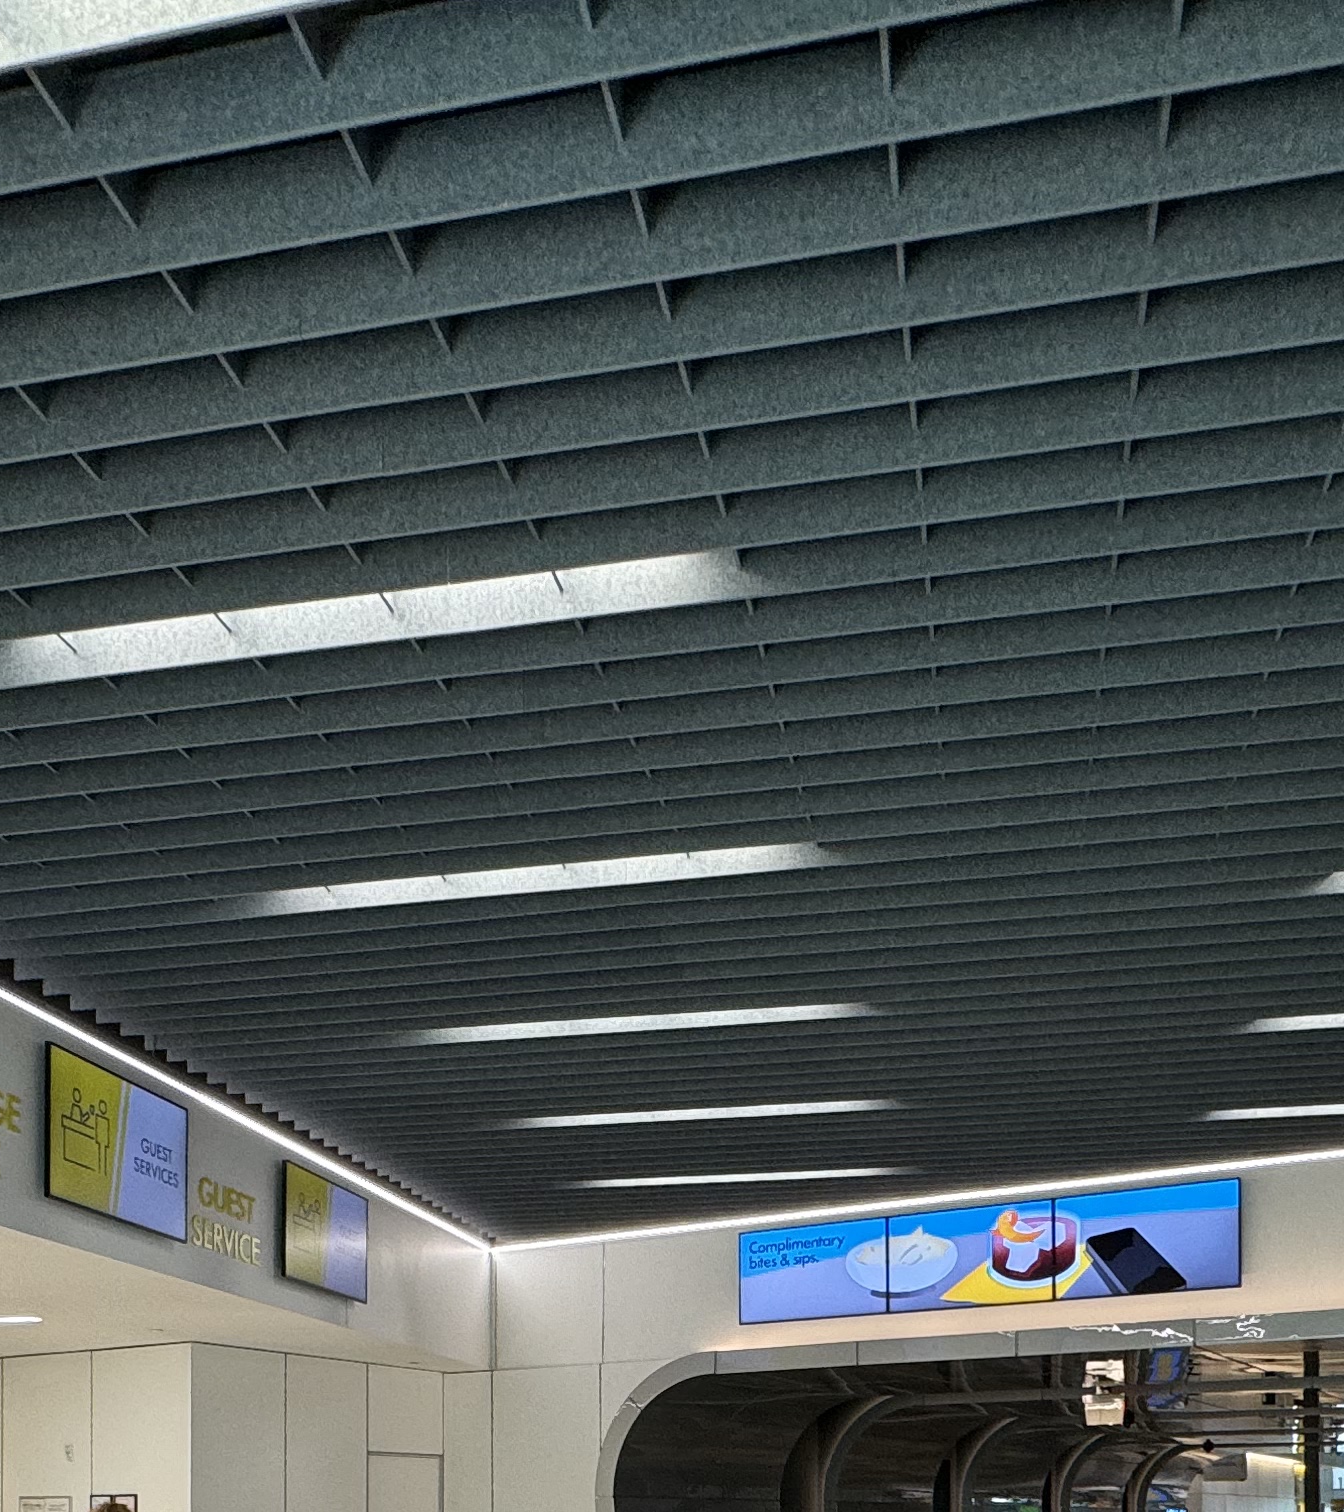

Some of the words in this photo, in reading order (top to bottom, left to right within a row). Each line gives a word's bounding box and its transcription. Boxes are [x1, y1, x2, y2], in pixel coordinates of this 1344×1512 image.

[140, 1138, 173, 1164] GUEST
[133, 1156, 179, 1189] SERVICES
[198, 1176, 256, 1224] GUEST
[191, 1214, 262, 1267] SERVICE
[748, 1235, 846, 1255] Complimentary
[748, 1256, 778, 1269] bites
[780, 1253, 790, 1267] &
[792, 1253, 820, 1269] sips.
